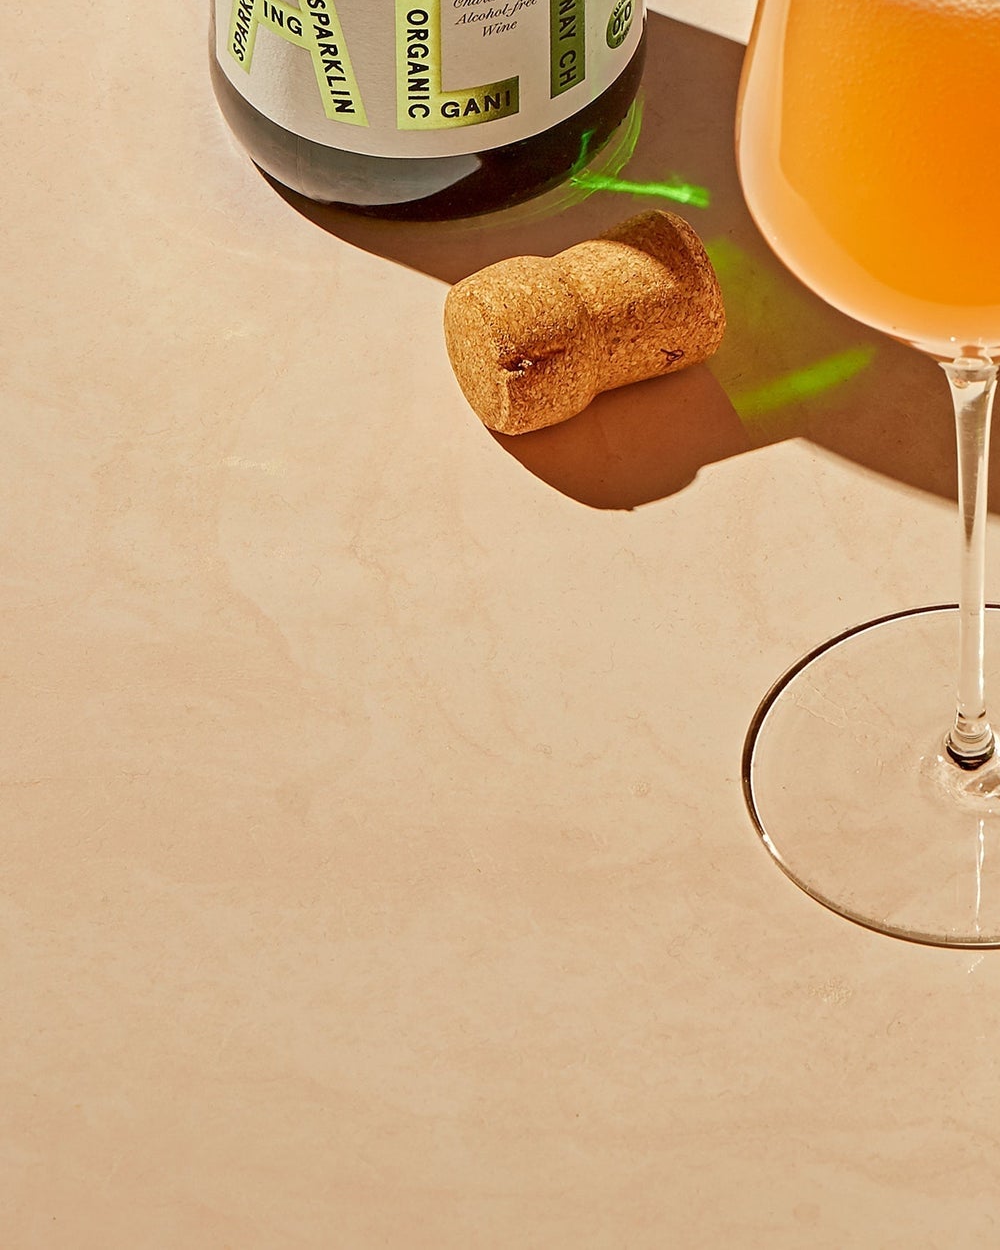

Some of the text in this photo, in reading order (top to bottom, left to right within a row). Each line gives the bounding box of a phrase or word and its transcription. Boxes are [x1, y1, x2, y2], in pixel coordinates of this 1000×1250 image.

[263, 0, 303, 37] ING
[482, 21, 518, 37] Wine
[406, 9, 430, 119] ORGANIC
[559, 50, 577, 87] CH
[440, 89, 511, 119] GANI
